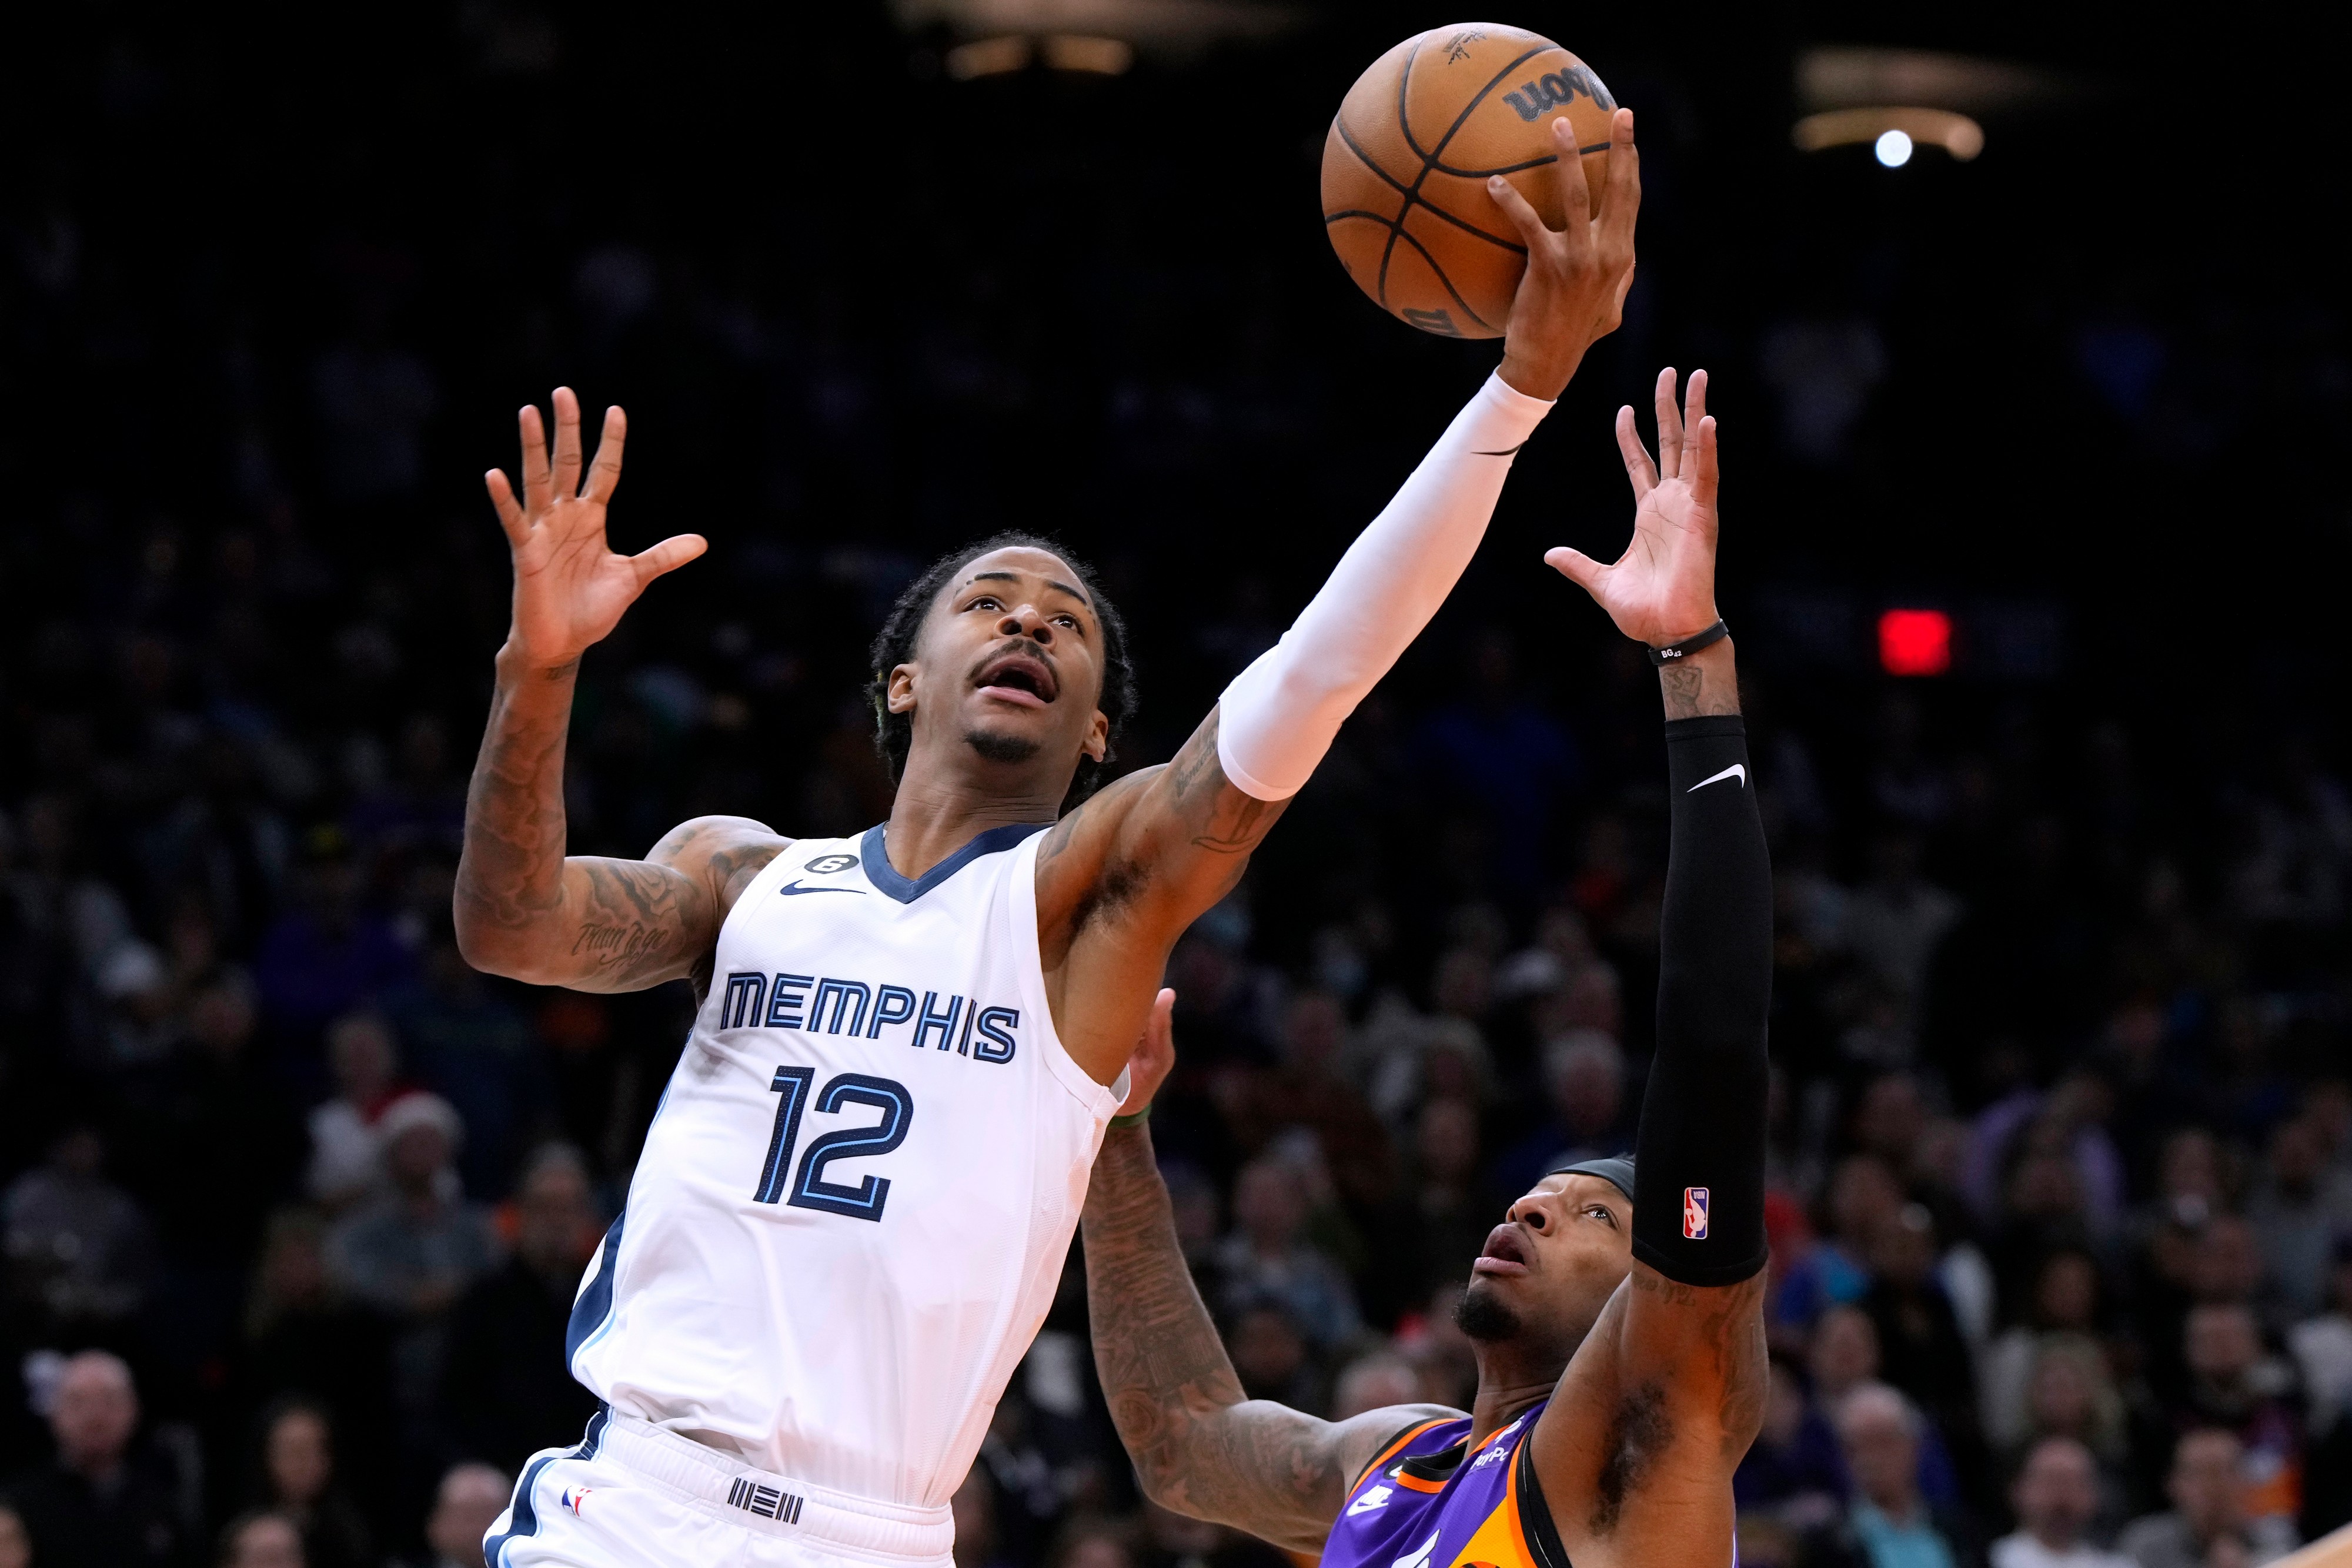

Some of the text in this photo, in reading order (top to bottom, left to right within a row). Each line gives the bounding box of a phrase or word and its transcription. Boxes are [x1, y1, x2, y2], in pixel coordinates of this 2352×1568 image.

[812, 857, 850, 872] 6
[720, 972, 1020, 1065] MEMPHIS
[753, 1065, 914, 1223] 12
